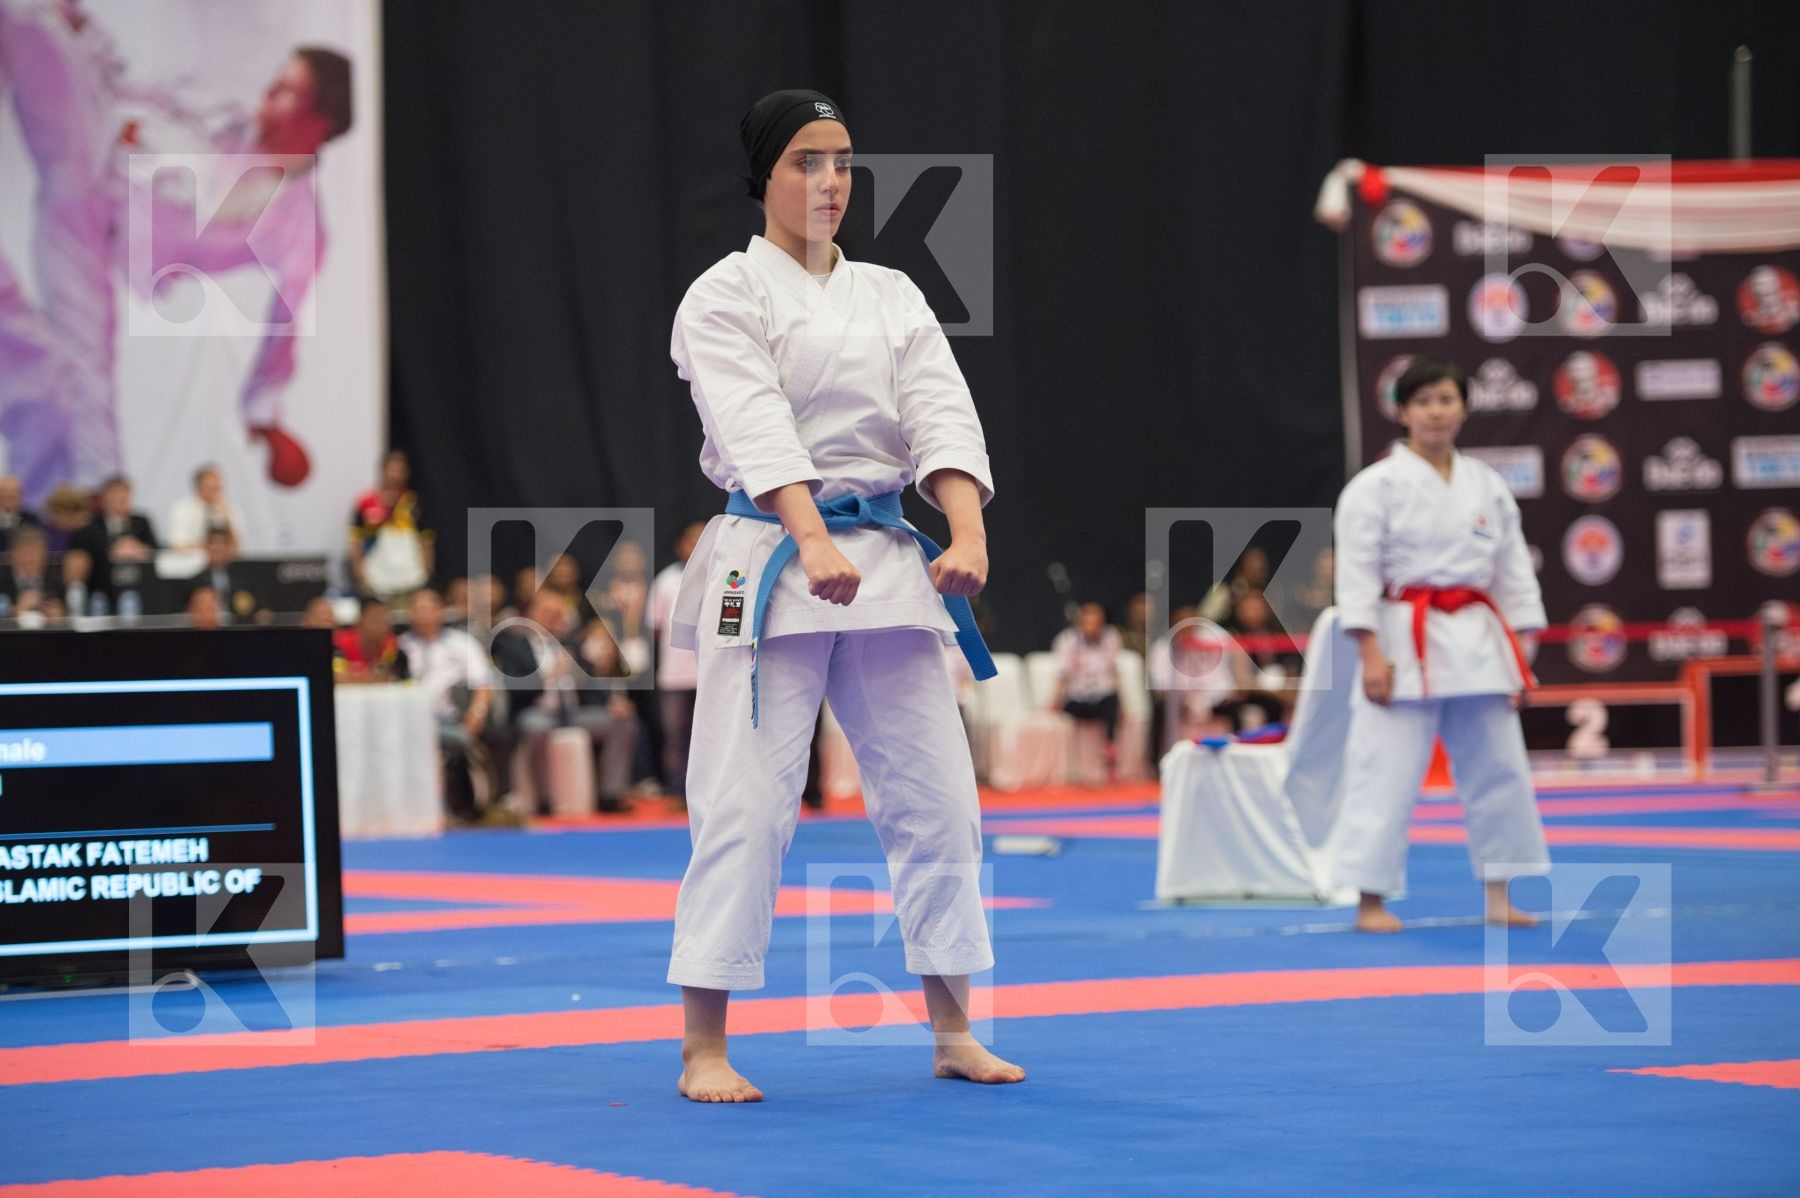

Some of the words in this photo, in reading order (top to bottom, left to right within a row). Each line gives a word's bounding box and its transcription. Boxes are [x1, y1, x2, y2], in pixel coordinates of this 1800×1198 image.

[1567, 698, 1610, 758] 2
[86, 838, 208, 867] FATEMEH
[0, 876, 87, 903] LAMIC
[91, 870, 221, 899] REPUBLIC
[224, 868, 262, 893] OF
